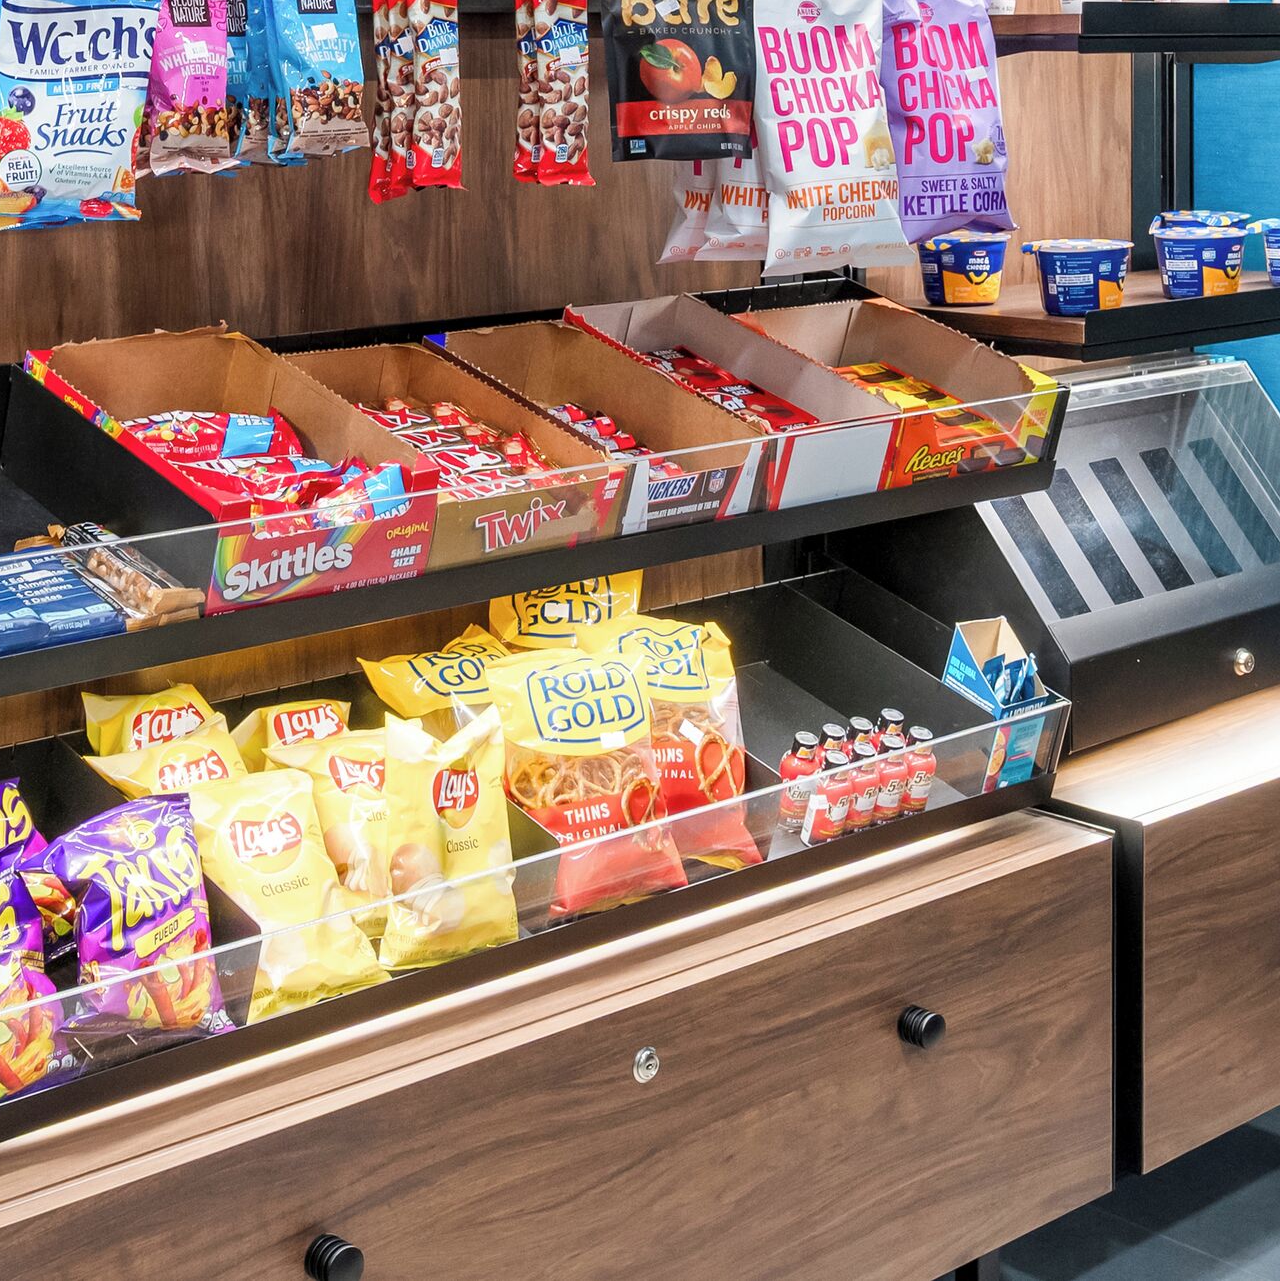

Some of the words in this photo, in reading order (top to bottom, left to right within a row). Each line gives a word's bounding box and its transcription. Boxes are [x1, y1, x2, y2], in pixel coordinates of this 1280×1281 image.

[427, 22, 453, 37] BLUE
[181, 63, 217, 76] MEDLEY
[770, 77, 884, 116] CHICKA
[897, 73, 997, 110] CHICKA
[53, 101, 118, 128] Fruit
[649, 107, 699, 121] crispy
[703, 105, 731, 119] reds
[35, 124, 126, 150] Snacks
[777, 117, 858, 173] POP
[904, 113, 975, 165] POP
[6, 170, 38, 181] FRUIT!
[8, 161, 33, 171] REAL
[786, 182, 833, 210] WHITE
[838, 180, 898, 204] CHEDDAR
[903, 194, 969, 216] KETTLE
[973, 191, 1007, 212] CORN
[823, 204, 875, 221] POPCORN
[391, 545, 422, 558] SHARE
[394, 557, 414, 568] SIZE
[223, 542, 353, 600] Skittles
[23, 584, 72, 597] Cashews
[541, 663, 625, 706] ROLD
[547, 691, 636, 732] GOLD
[437, 769, 478, 810] Lay's
[564, 802, 610, 825] THINS
[446, 837, 479, 854] Classic
[261, 875, 309, 897] Classic
[154, 922, 178, 945] FUEGO
